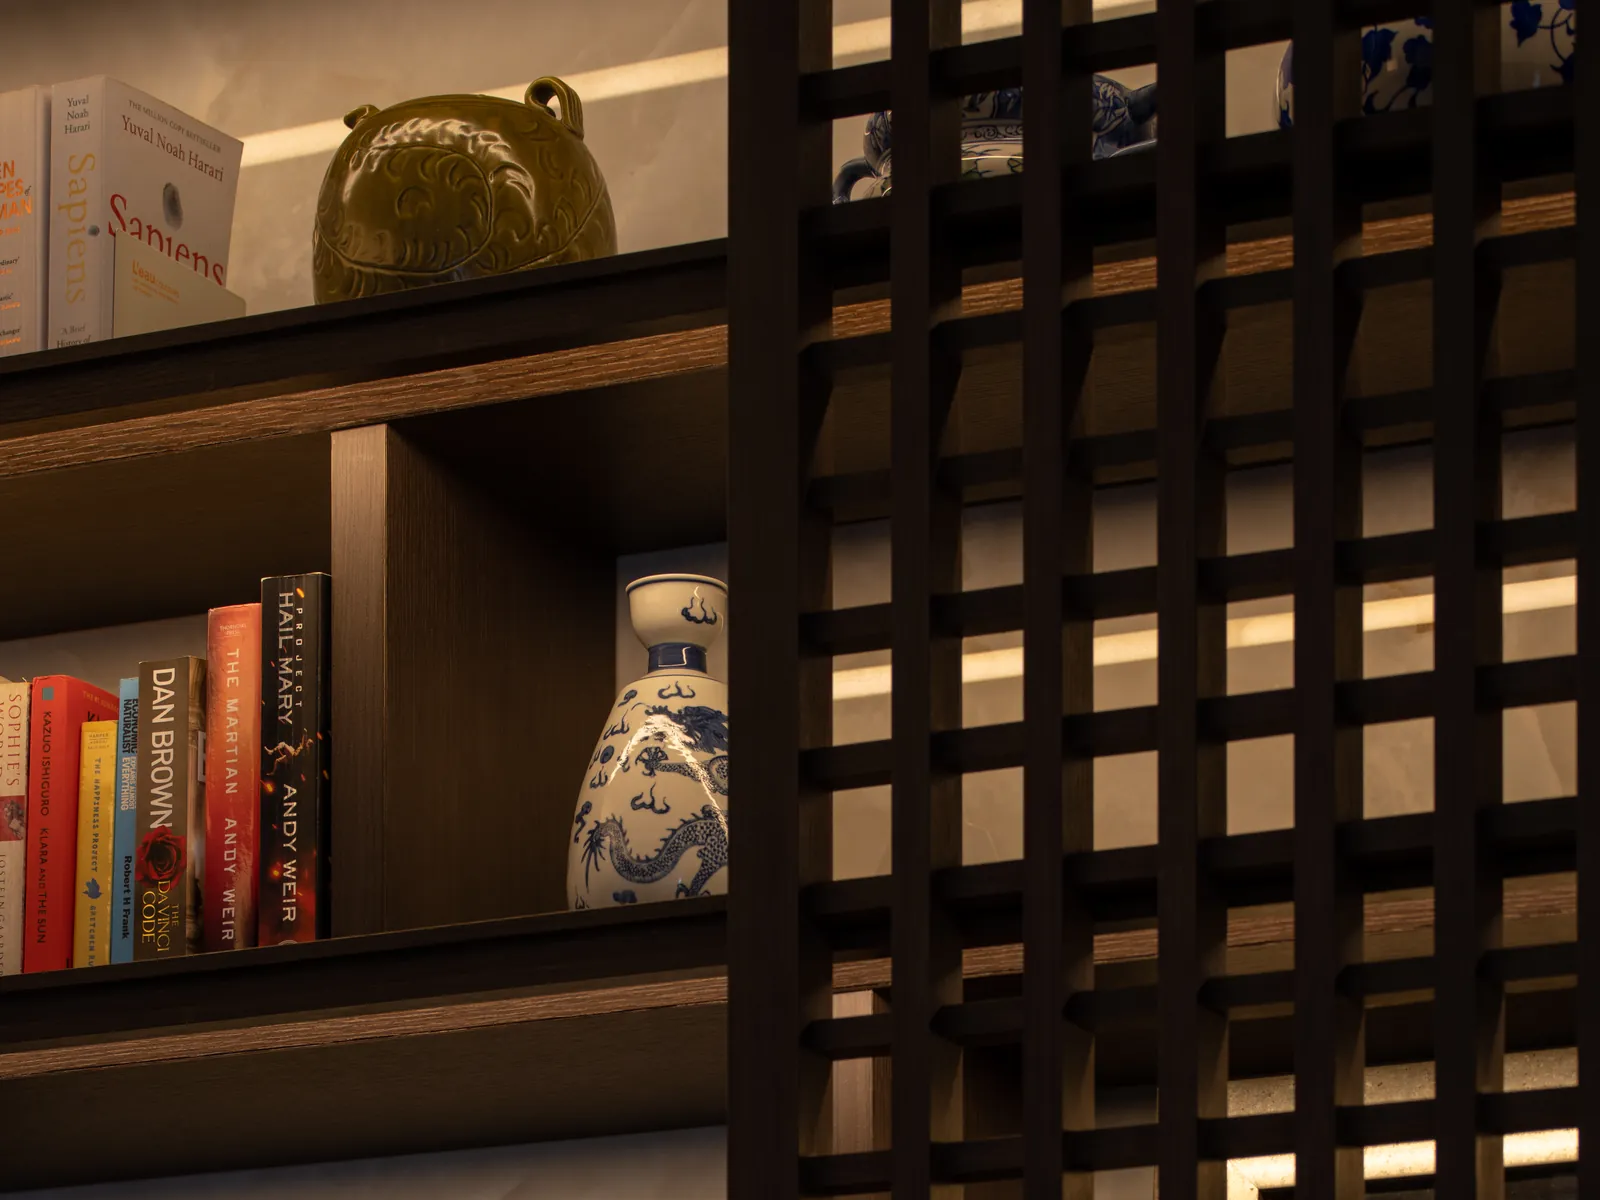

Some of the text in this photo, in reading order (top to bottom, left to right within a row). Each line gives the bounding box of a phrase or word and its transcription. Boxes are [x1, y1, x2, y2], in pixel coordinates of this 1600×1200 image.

[64, 121, 90, 135] Harari
[66, 94, 89, 108] Yuval
[66, 108, 89, 121] Noah
[128, 99, 221, 154] THE MILLION COPY BESTSELLER
[122, 114, 224, 182] Yuval Noah Harari
[57, 153, 96, 305] Sapiens
[69, 322, 86, 334] Brief
[277, 591, 294, 725] HAIL MARY
[294, 607, 303, 709] PROJECT
[6, 693, 22, 787] SOPHIE'S
[122, 698, 132, 754] NATURALIST
[149, 668, 176, 829] DAN BROWN
[94, 758, 102, 775] THE
[120, 756, 131, 811] EVERYTHING
[128, 756, 137, 810] EXPLAINS ALMOST
[92, 778, 101, 830] HAPPINESS
[220, 648, 240, 941] THE MARTIAN ANDY WEIR
[36, 711, 52, 944] KAZUO ISHIGURO KLARA AND THE SUN
[90, 833, 99, 873] PROJECT
[281, 783, 298, 923] ANDY WEIR
[121, 855, 132, 940] Robert H Frank
[140, 890, 157, 944] CODE
[156, 880, 171, 952] DA VINCI
[170, 903, 180, 927] THE
[88, 905, 97, 952] GRETCHEN
